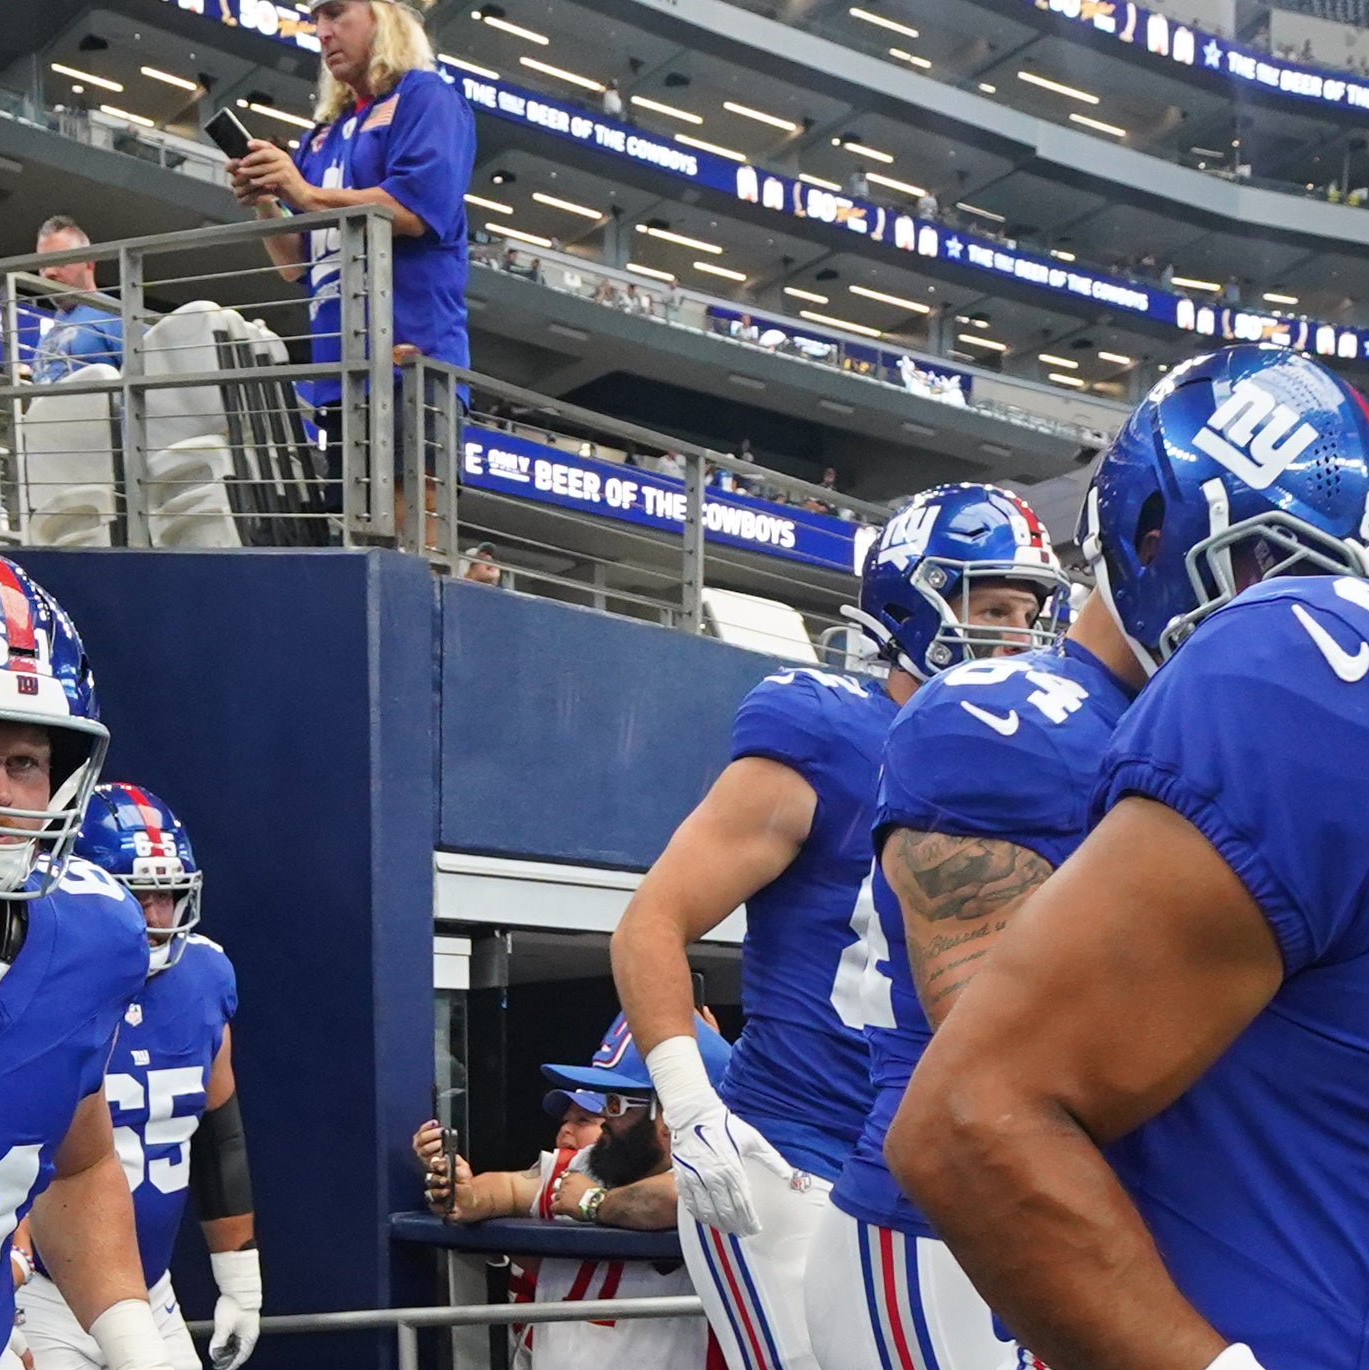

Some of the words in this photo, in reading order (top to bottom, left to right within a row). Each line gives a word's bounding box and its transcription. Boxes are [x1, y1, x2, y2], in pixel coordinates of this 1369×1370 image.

[534, 459, 601, 502] BEER
[605, 478, 638, 510] OF
[642, 486, 688, 522] THE
[133, 831, 177, 857] 65
[104, 1065, 207, 1195] 65
